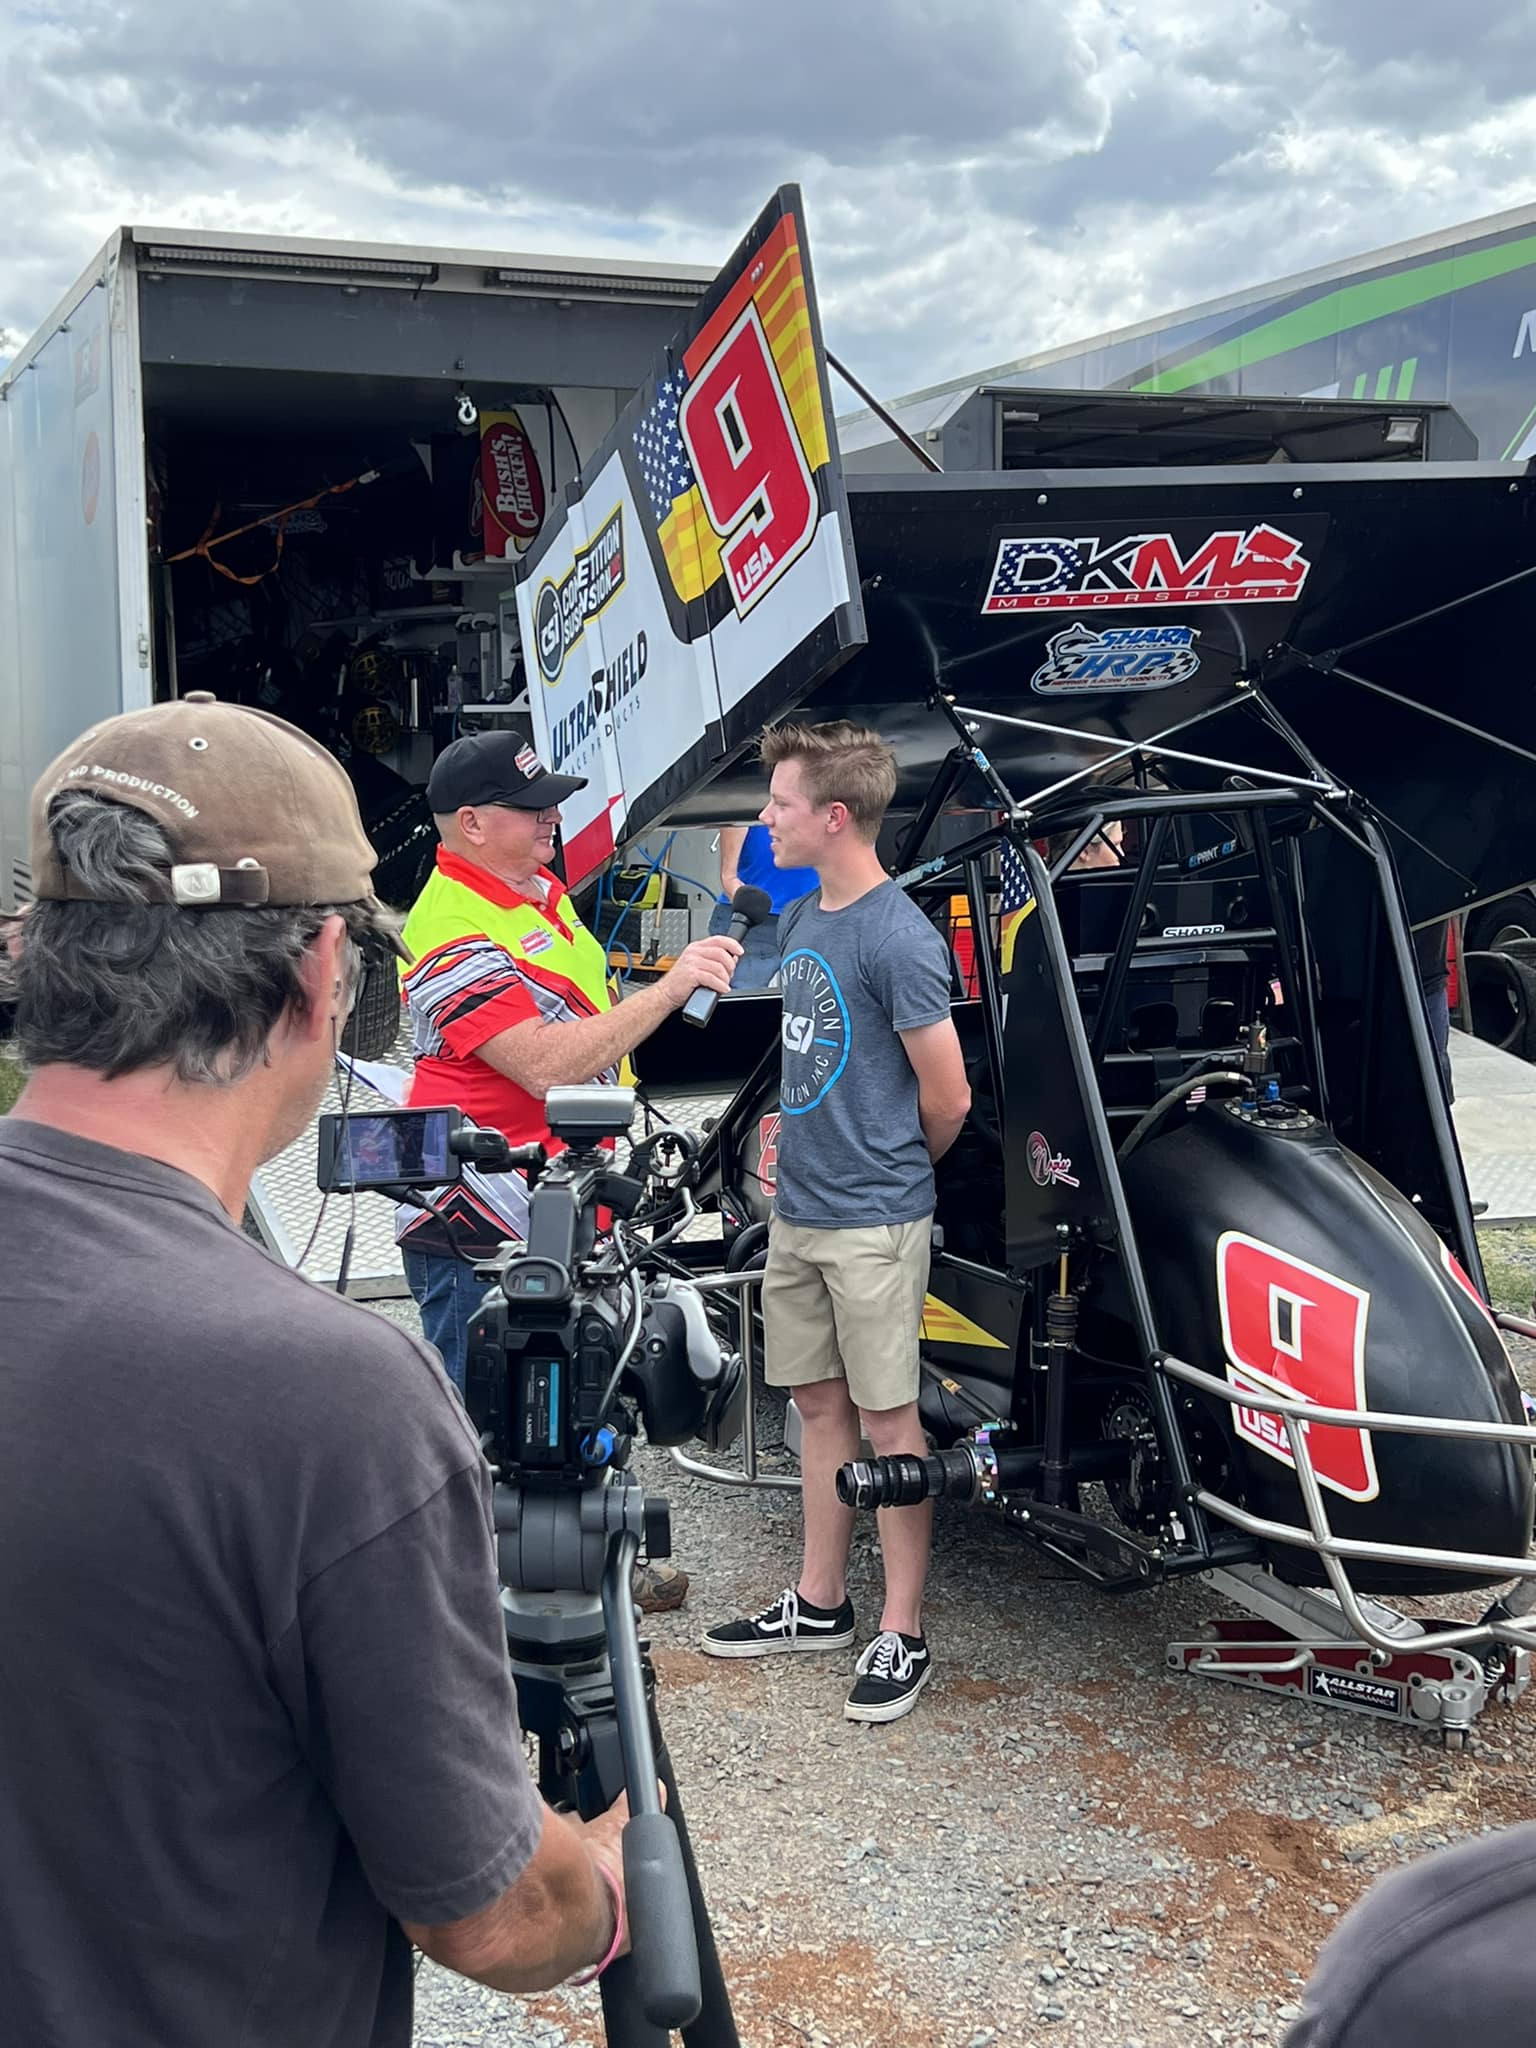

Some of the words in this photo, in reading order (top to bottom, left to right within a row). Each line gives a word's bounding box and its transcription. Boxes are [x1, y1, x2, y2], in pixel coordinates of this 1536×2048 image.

[490, 438, 518, 512] BUSH'S
[500, 433, 539, 528] CHICKEN!
[679, 298, 818, 618] 9
[736, 541, 774, 595] USA
[997, 586, 1286, 608] MOTORSPORT
[1068, 650, 1177, 680] HRP
[91, 765, 200, 819] PRODUCTION
[1217, 1231, 1380, 1503] 9
[1329, 1678, 1396, 1698] ALLSTAR
